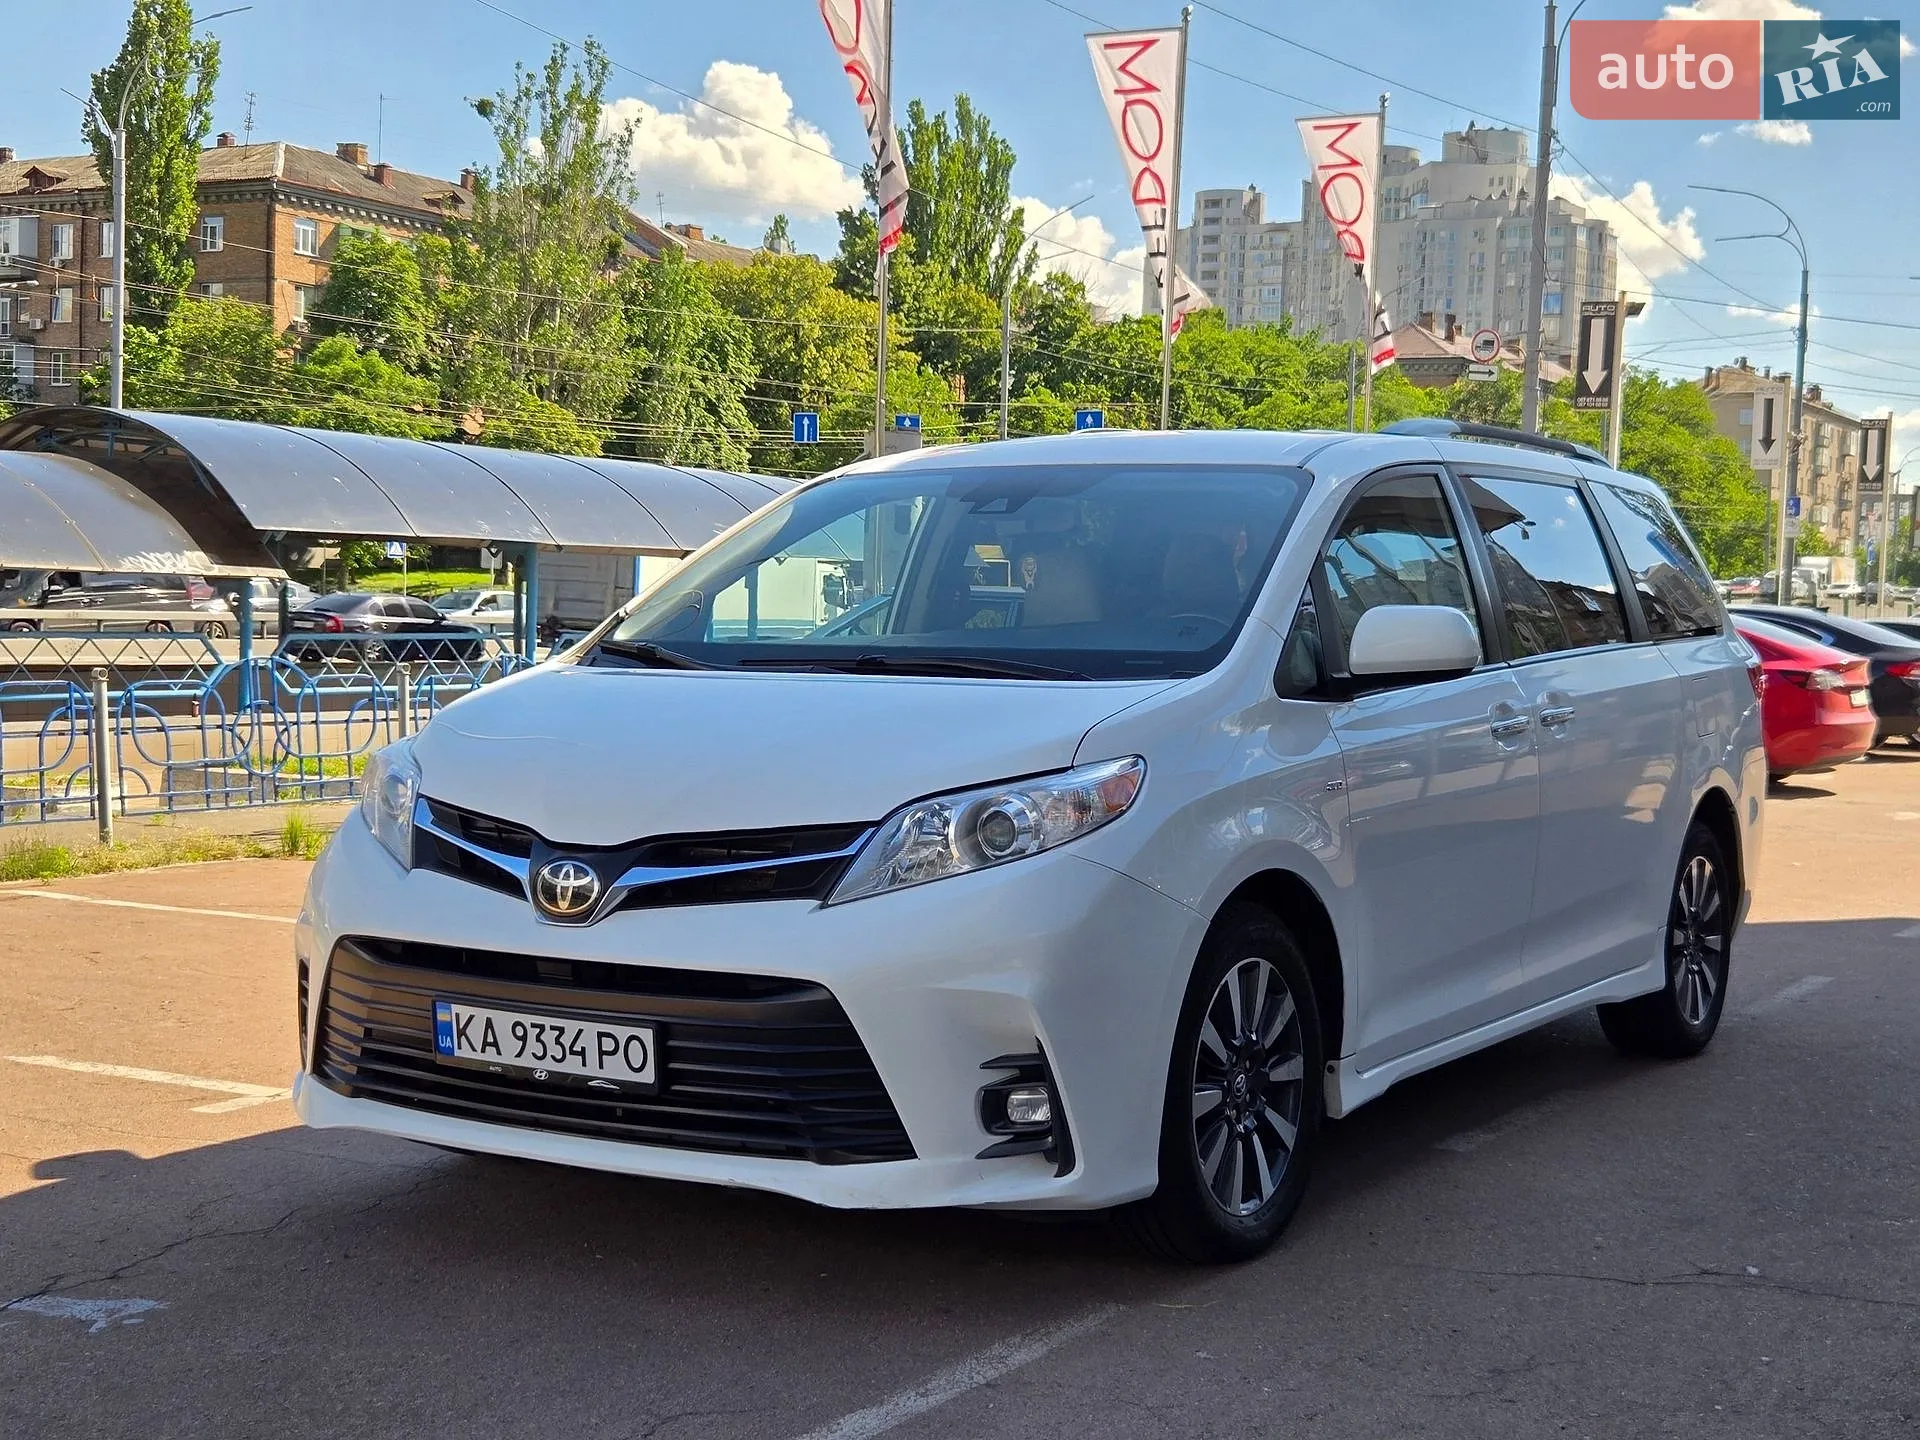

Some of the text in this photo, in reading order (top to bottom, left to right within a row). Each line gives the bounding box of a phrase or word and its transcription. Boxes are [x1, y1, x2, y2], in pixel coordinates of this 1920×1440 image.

[438, 1035, 453, 1049] UA
[455, 1011, 648, 1074] KA 9334 PO
